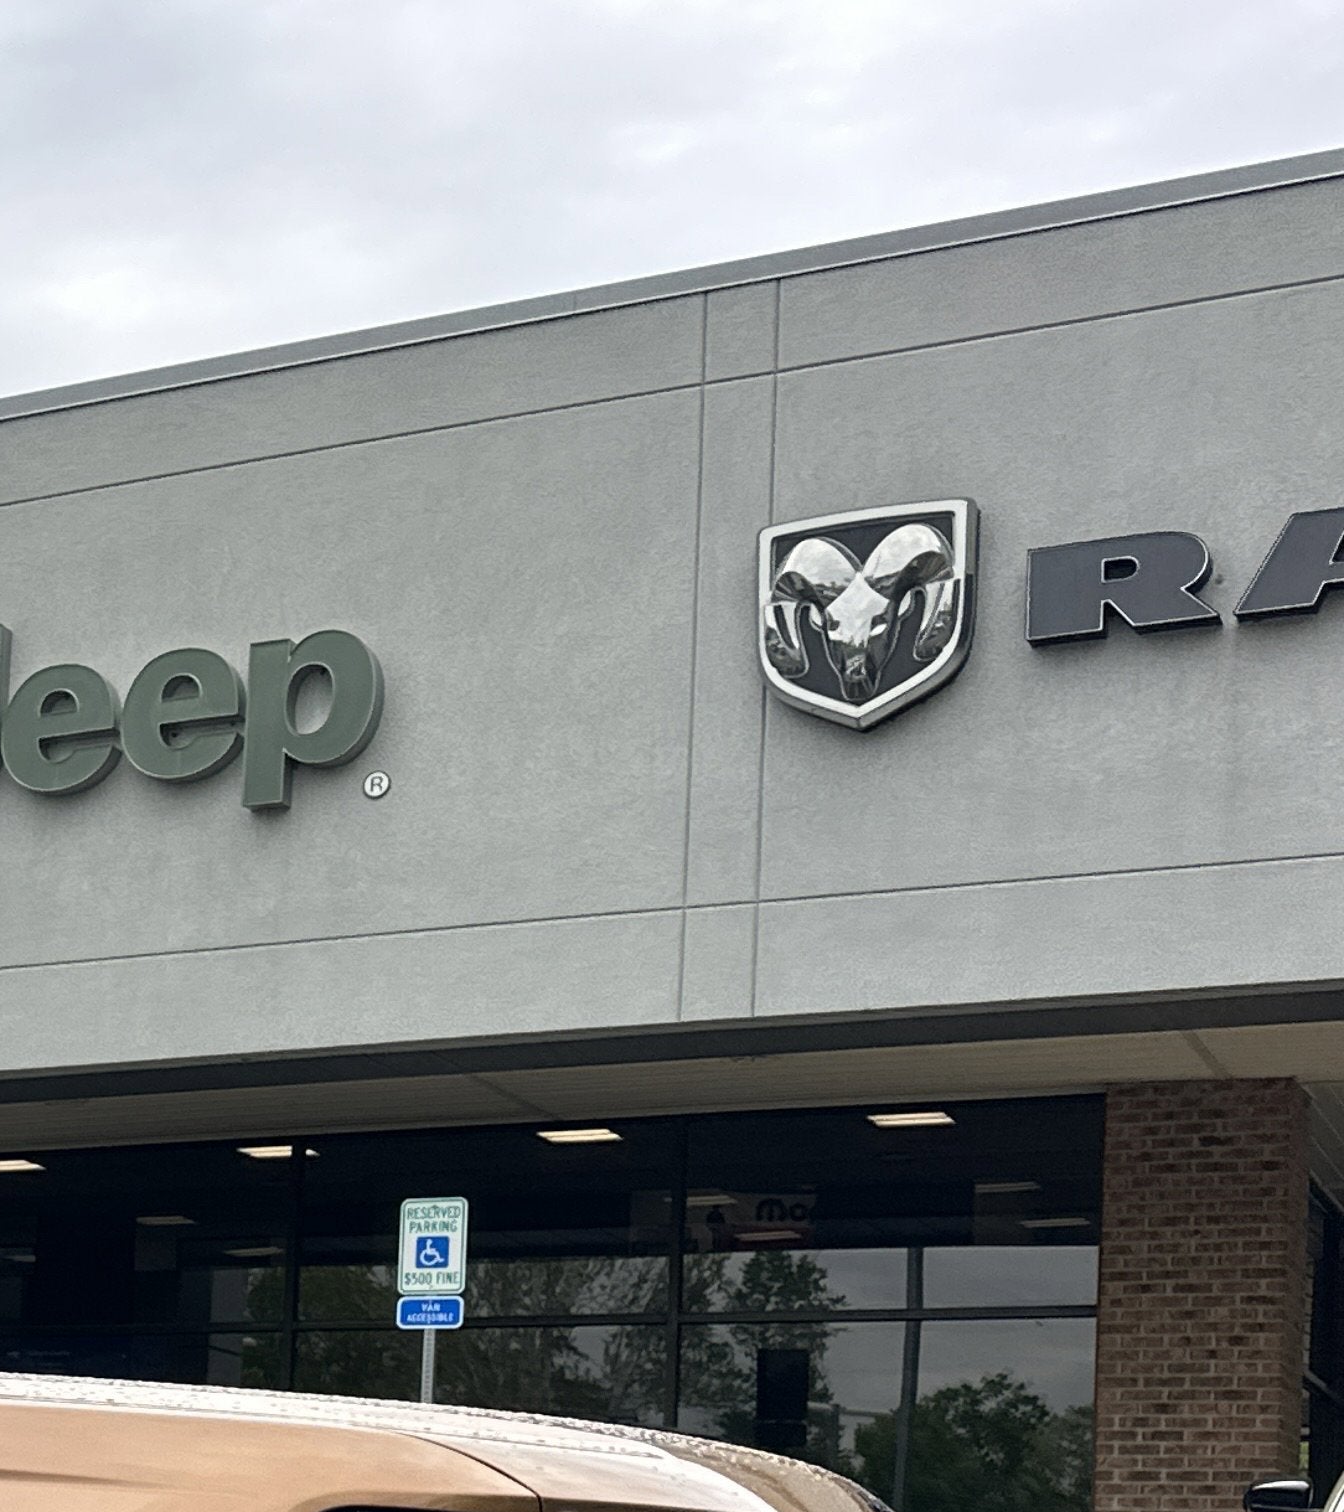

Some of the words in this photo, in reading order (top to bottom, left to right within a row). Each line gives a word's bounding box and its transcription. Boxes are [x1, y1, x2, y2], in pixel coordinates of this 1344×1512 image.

[407, 1206, 461, 1219] RESERVED
[409, 1220, 458, 1233] PARKING
[404, 1273, 432, 1285] $500
[436, 1272, 459, 1284] FINE
[421, 1303, 441, 1312] VAN
[406, 1312, 454, 1323] ACCESSIBLE
